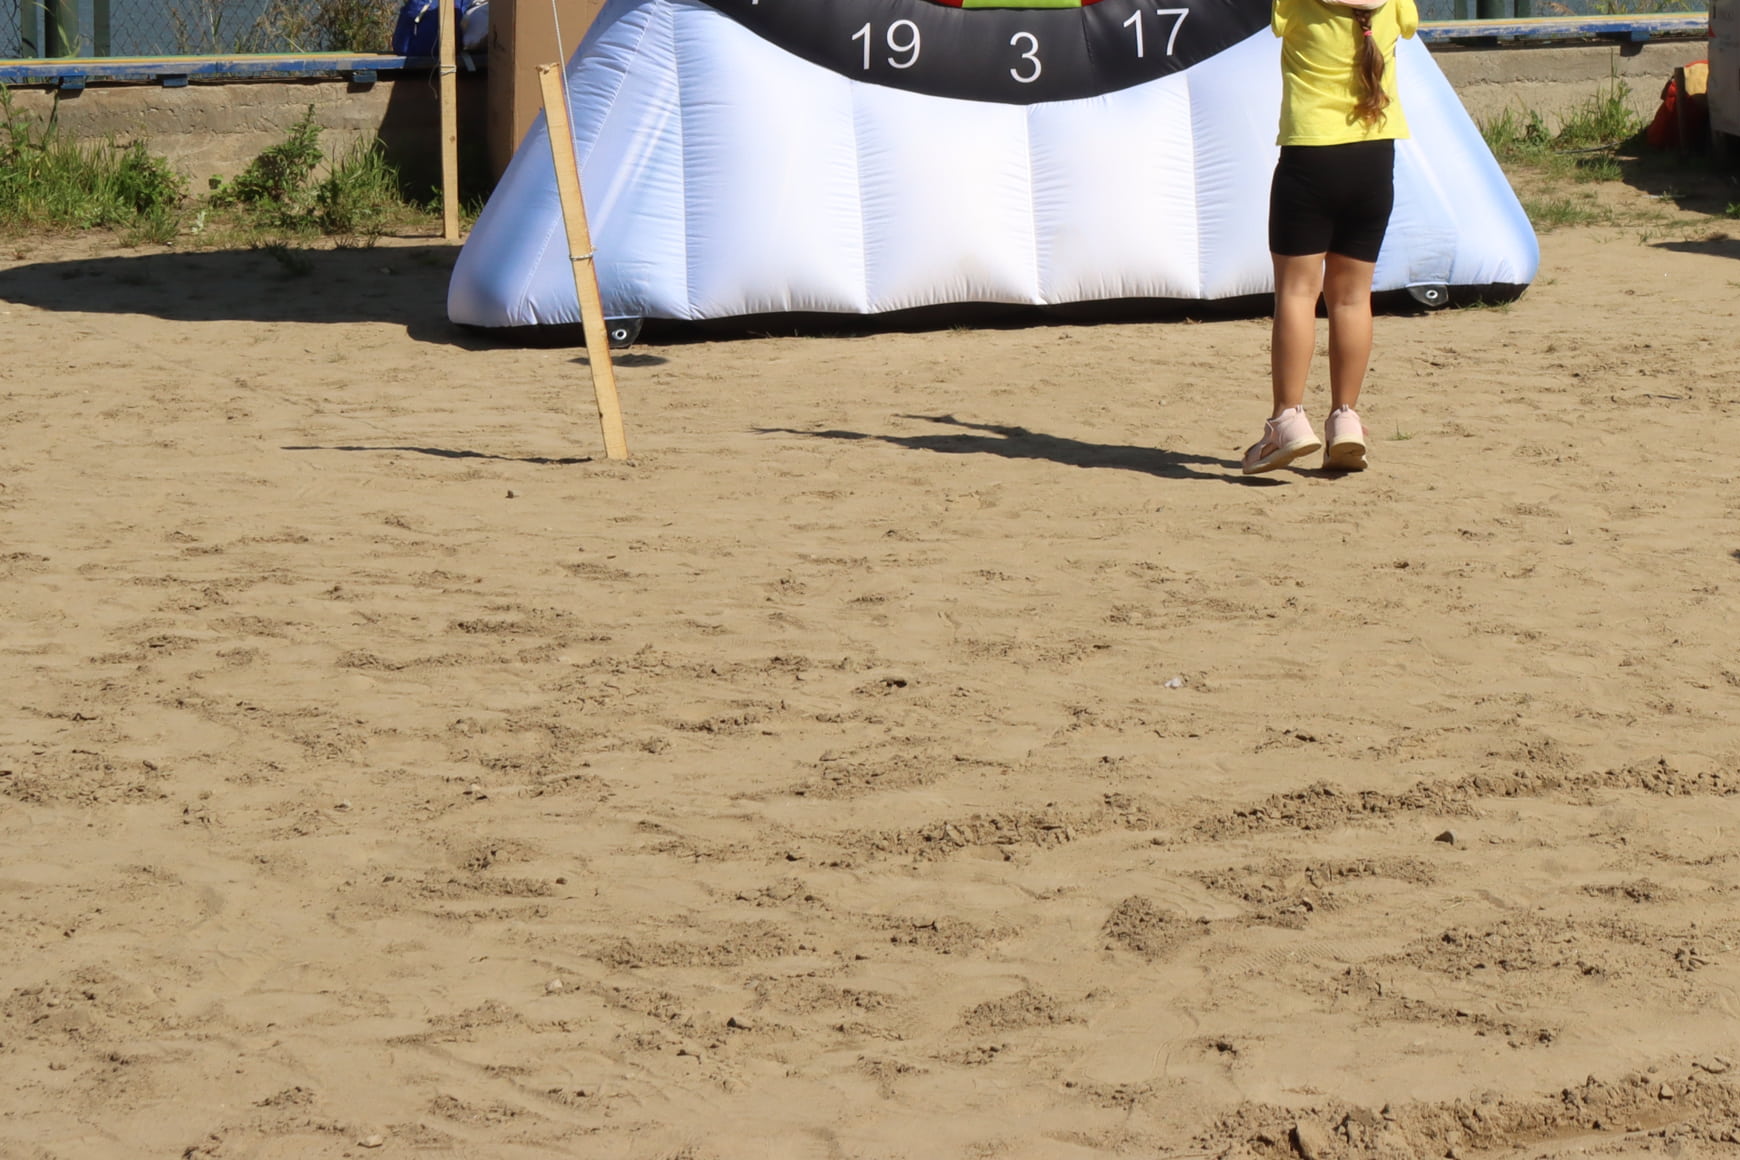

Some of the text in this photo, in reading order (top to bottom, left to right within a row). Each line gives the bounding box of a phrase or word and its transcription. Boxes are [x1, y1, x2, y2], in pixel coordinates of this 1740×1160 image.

[851, 19, 921, 70] 19
[1010, 31, 1042, 83] 3
[1123, 7, 1190, 58] 17
